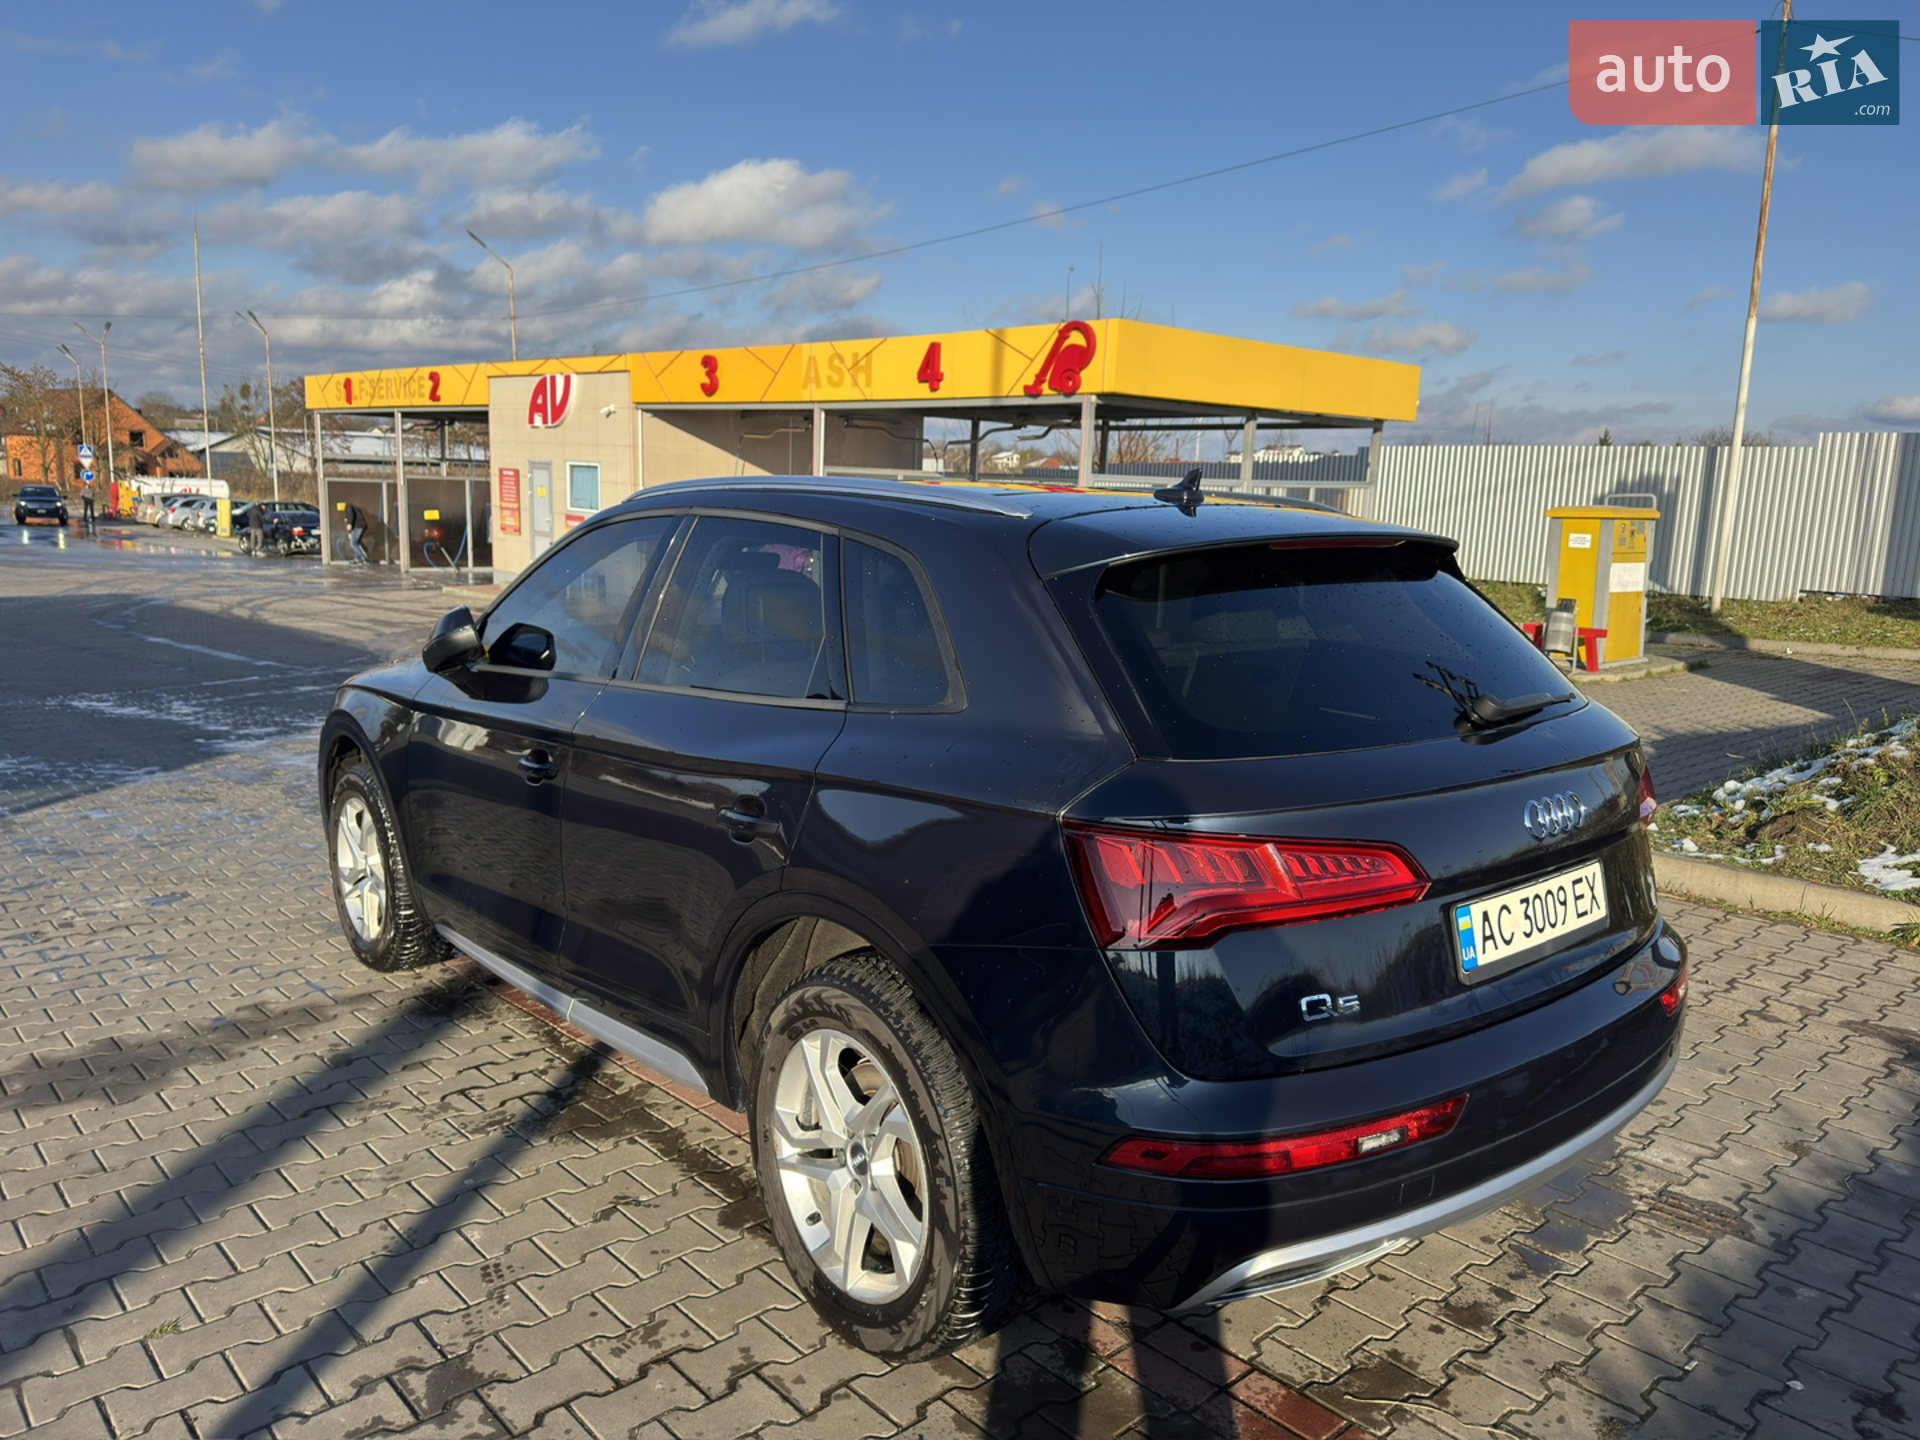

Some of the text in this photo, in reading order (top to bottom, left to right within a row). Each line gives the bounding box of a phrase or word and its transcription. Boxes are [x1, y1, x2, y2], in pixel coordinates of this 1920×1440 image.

[700, 354, 720, 398] 3
[801, 352, 873, 390] ASH
[917, 341, 945, 392] 4
[335, 375, 426, 402] SF-SERVICE
[343, 377, 353, 406] 1
[428, 371, 442, 403] 2
[1481, 871, 1601, 955] AC 3009 EX
[1462, 946, 1476, 961] UA
[1300, 993, 1361, 1022] Q5
